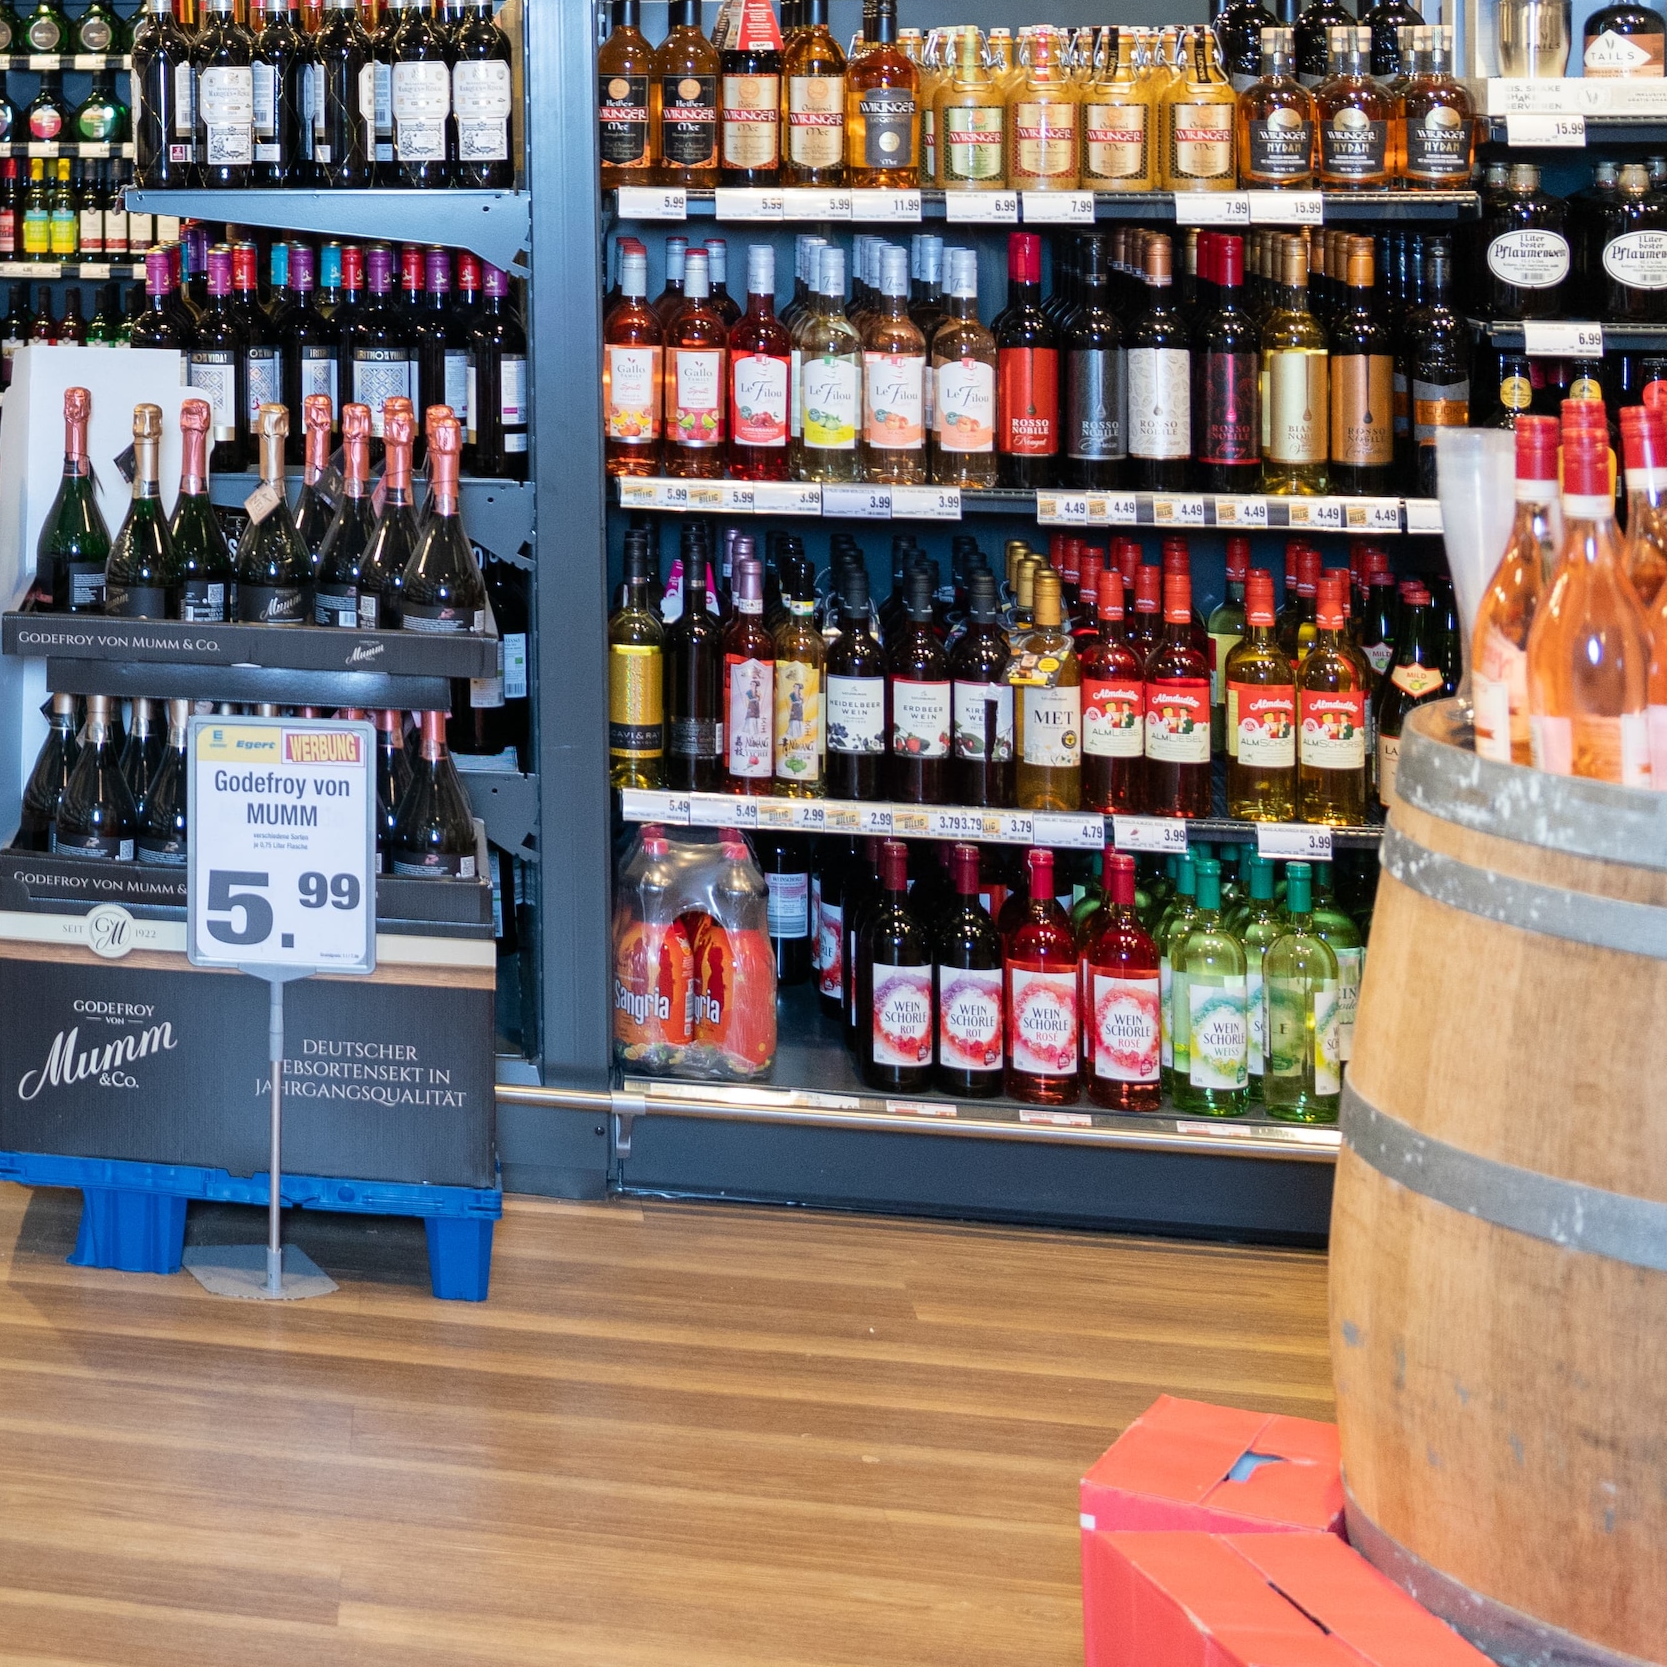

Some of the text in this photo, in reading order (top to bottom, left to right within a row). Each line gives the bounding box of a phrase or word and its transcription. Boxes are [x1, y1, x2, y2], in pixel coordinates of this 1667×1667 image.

[1591, 52, 1634, 61] TAILS
[860, 101, 915, 113] WIKINGER
[663, 108, 715, 120] WIKINGER
[724, 109, 776, 121] WIKINGER
[789, 114, 843, 125] WIKINGER
[1019, 128, 1071, 139] WIKINGER
[1259, 130, 1307, 140] WIKINGER
[1327, 130, 1376, 140] WIKINGER
[1555, 123, 1585, 135] 15.99
[950, 132, 1001, 143] WIKINGER
[1088, 131, 1141, 142] WIKINGER
[1176, 130, 1230, 141] WIKINGER
[664, 196, 684, 208] 5.99
[830, 198, 850, 210] 5.99
[894, 199, 919, 211] 11.99
[995, 199, 1016, 212] 6.99
[1072, 200, 1092, 212] 7.99
[1226, 202, 1248, 214] 7.99
[1294, 202, 1321, 214] 15.99
[1525, 234, 1544, 242] Liter
[1579, 333, 1601, 345] 6.99
[618, 364, 646, 374] Gallo
[684, 368, 713, 377] Gallo
[741, 381, 782, 401] Le Filou
[947, 386, 989, 406] Le Filou
[1012, 418, 1049, 427] ROSSO
[1012, 427, 1049, 435] NOBILE
[667, 488, 687, 500] 5.99
[733, 492, 753, 503] 5.99
[800, 492, 820, 503] 3.99
[870, 496, 890, 508] 3.99
[939, 496, 959, 508] 3.99
[1064, 502, 1086, 514] 4.49
[1114, 502, 1135, 514] 4.49
[1182, 505, 1203, 516] 4.49
[1375, 510, 1396, 521] 4.49
[260, 593, 302, 620] Mumm
[18, 631, 95, 646] GODEFROY
[98, 635, 128, 647] VON
[132, 636, 180, 650] MUMM
[183, 639, 194, 651] &
[345, 642, 385, 665] Mumm
[1406, 672, 1427, 680] MILD
[829, 699, 880, 708] HEIDELBEER
[1152, 693, 1200, 708] Almdudler
[842, 708, 868, 716] WEIN
[903, 704, 943, 713] ERDBEER
[911, 712, 937, 720] WEIN
[1034, 709, 1074, 724] MET
[236, 740, 275, 749] Egert
[289, 733, 356, 762] WERBUNG
[215, 770, 350, 799] Godefroy von
[669, 801, 689, 813] 5.49
[736, 805, 756, 817] 5.49
[247, 803, 317, 826] MUMM
[803, 809, 824, 821] 2.99
[939, 816, 960, 829] 3.79
[1082, 826, 1103, 839] 4.79
[1164, 830, 1186, 842] 3.99
[286, 842, 308, 850] Flasche
[1309, 836, 1331, 848] 3.99
[14, 871, 88, 889] GODEFROY
[93, 879, 123, 891] VON
[127, 882, 174, 894] MUMM
[62, 924, 83, 933] SEIT
[135, 929, 156, 938] 1922
[73, 1000, 154, 1017] GODEFROY
[615, 980, 670, 1025] Sangria
[894, 1001, 920, 1013] WEIN
[106, 1016, 125, 1025] VON
[885, 1011, 927, 1023] SCHORLE
[1115, 1014, 1142, 1026] WEIN
[900, 1025, 915, 1034] ROT
[1105, 1024, 1150, 1037] SCHORLE
[1213, 1022, 1239, 1034] WEIN
[1118, 1036, 1140, 1049] ROSÉ
[1203, 1032, 1245, 1046] SCHORLE
[303, 1039, 418, 1060] DEUTSCHER
[18, 1021, 178, 1101] Mumm
[283, 1059, 450, 1084] EBSORTENSEKT IN
